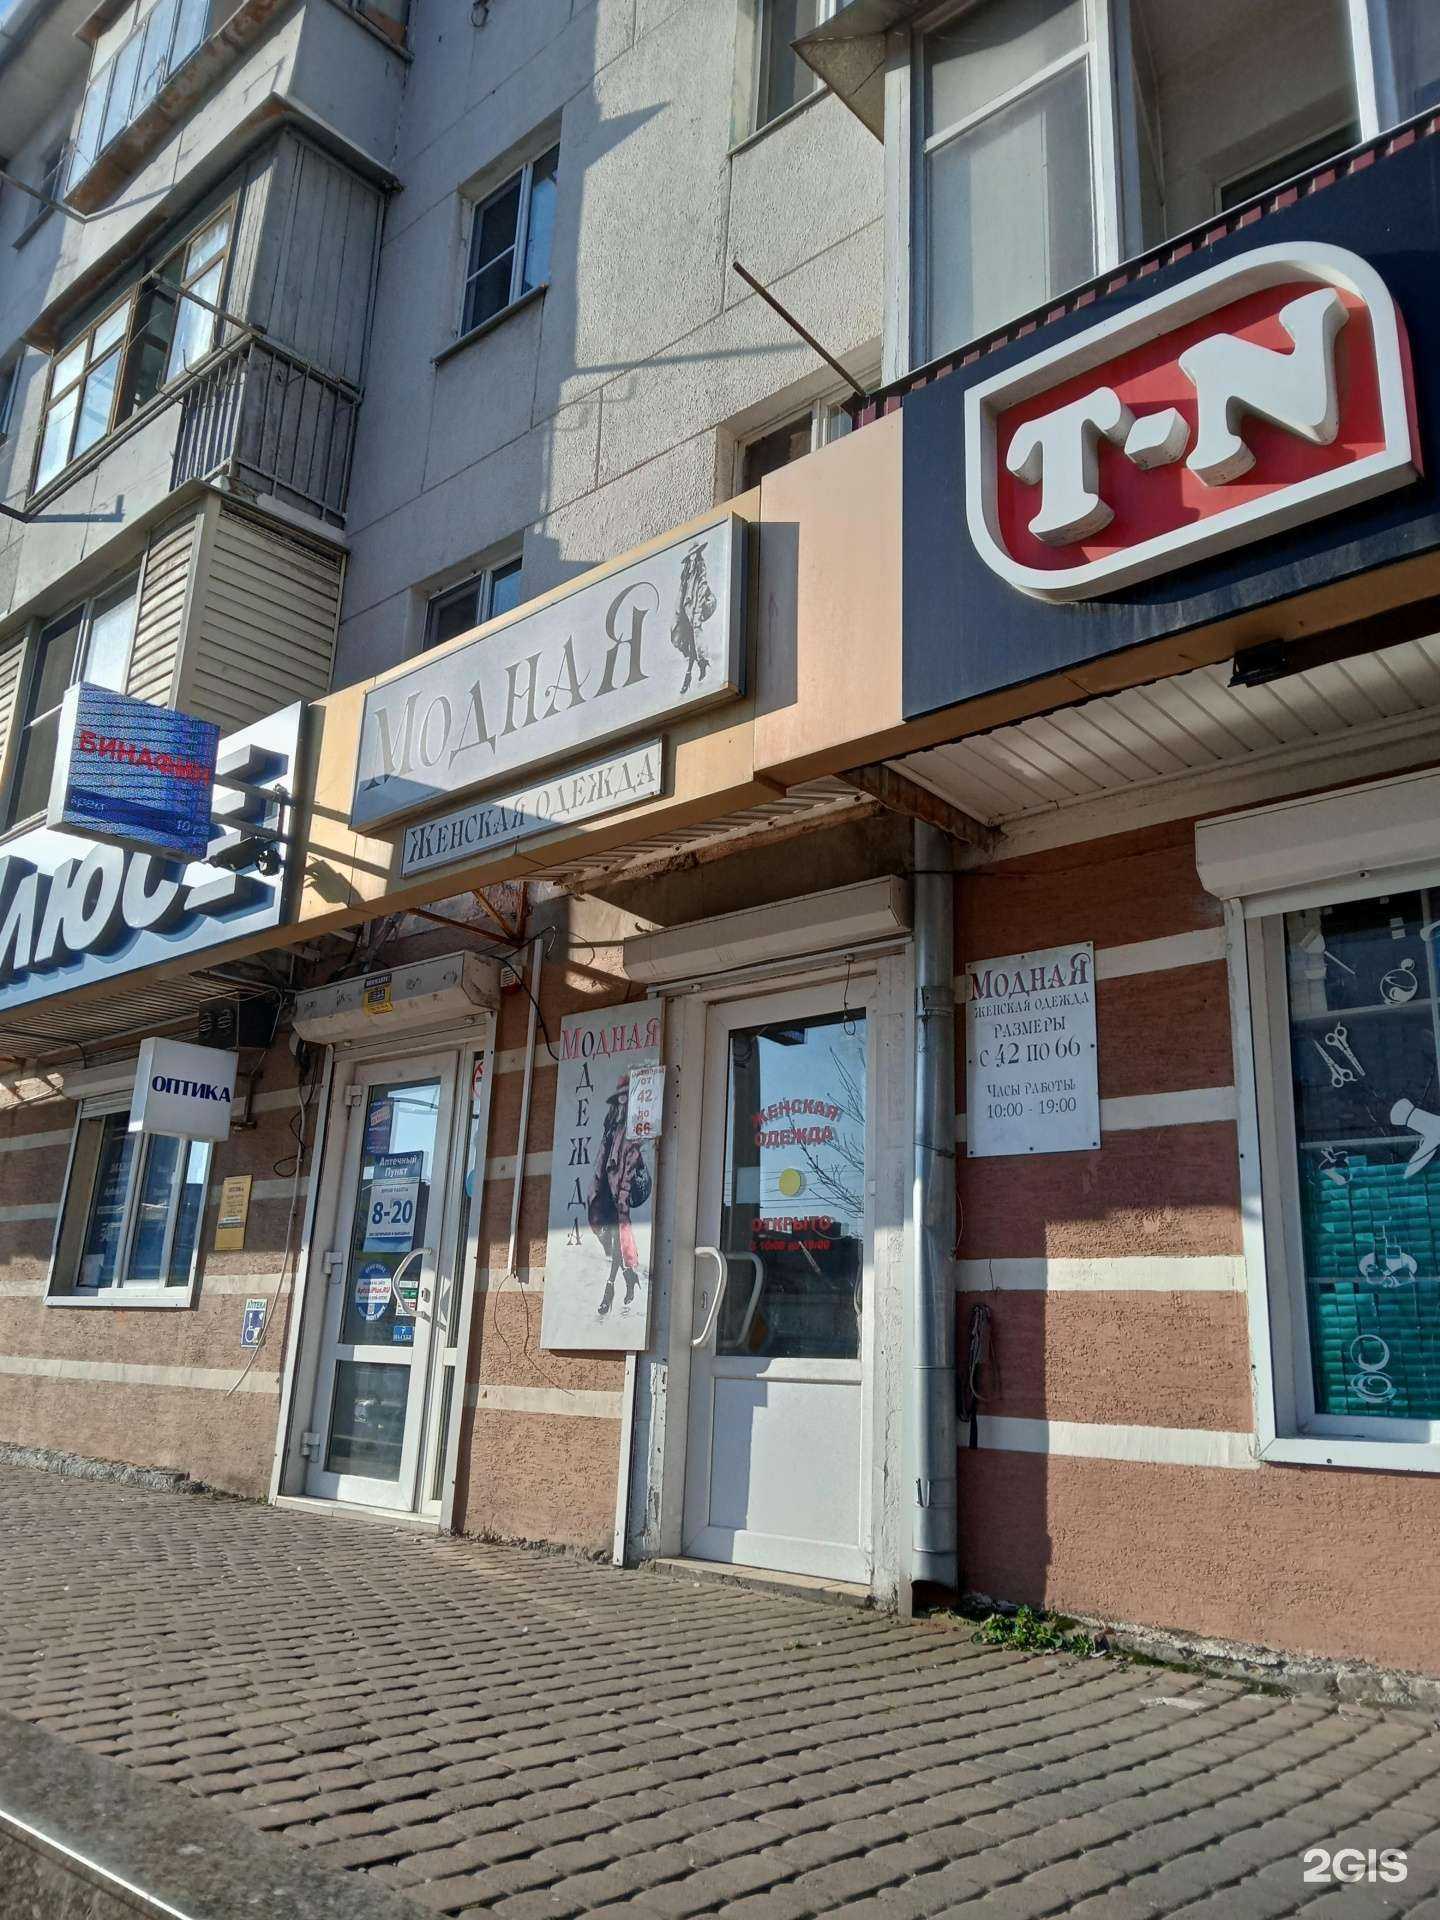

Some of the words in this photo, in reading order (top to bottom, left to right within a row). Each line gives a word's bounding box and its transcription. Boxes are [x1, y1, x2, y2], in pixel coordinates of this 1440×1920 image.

[362, 581, 660, 792] МОДНАЯ
[407, 797, 526, 864] ЖЕНСКАЯ
[535, 752, 656, 826] ОДЕЖДА
[970, 952, 1091, 1001] МОДНАЯ
[974, 1000, 1031, 1018] ЖЕНСКАЯ
[1034, 991, 1090, 1010] ОДЕЖДА
[560, 1017, 660, 1061] МОДНАЯ
[994, 1016, 1066, 1039] РАЗМЕРЫ
[995, 1042, 1020, 1068] 42
[1026, 1042, 1051, 1063] ПО
[1055, 1035, 1081, 1058] 66
[151, 1075, 232, 1104] ОПТИКА
[637, 1089, 653, 1104] 42
[986, 1083, 1021, 1099] ЧАСЫ
[1024, 1078, 1077, 1096] РАБОТЫ
[752, 1099, 839, 1127] ЖЕНСКАЯ
[987, 1102, 1024, 1119] 10:00
[1039, 1096, 1077, 1115] 19:00
[634, 1121, 651, 1137] 66
[755, 1125, 833, 1148] ОДЕЖДА
[385, 1167, 408, 1178] Пункт
[372, 1200, 413, 1224] 8-20
[752, 1215, 832, 1233] ОТКРЫТО
